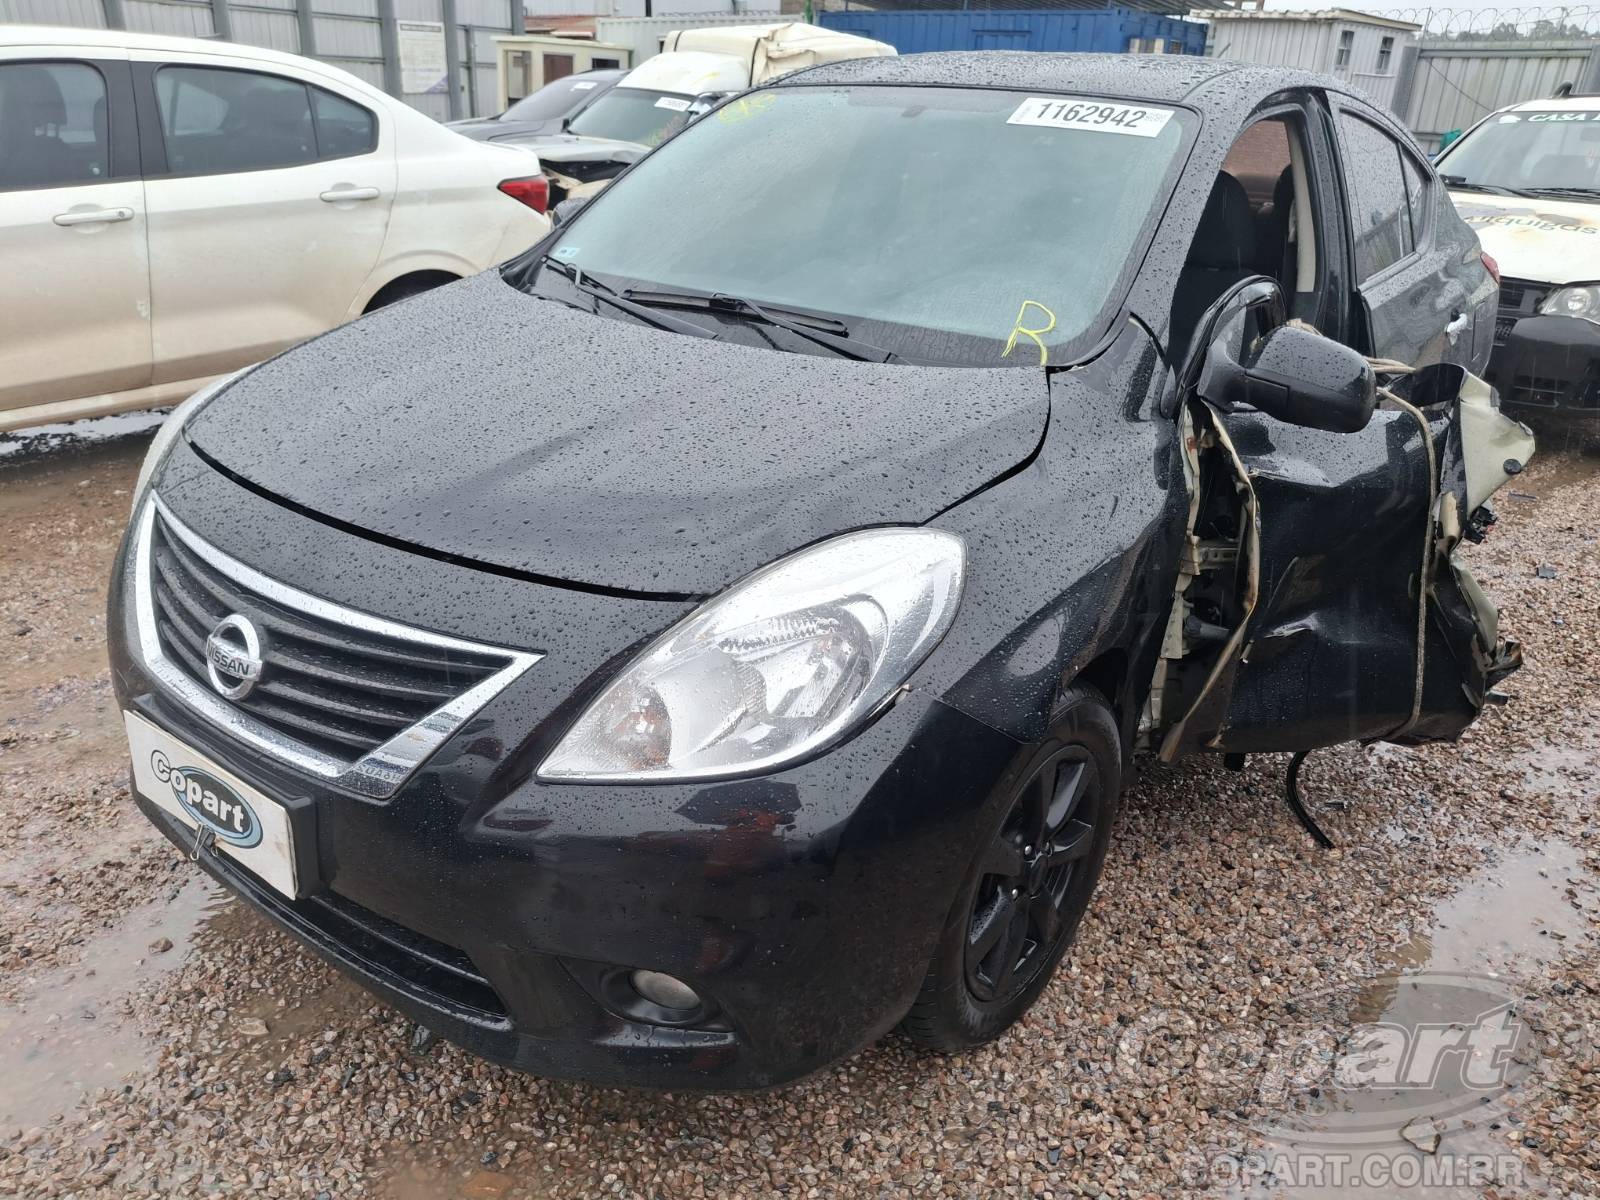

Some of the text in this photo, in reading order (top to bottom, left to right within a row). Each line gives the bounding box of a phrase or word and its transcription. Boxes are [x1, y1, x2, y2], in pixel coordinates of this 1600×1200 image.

[1036, 101, 1148, 129] 1162942
[1528, 113, 1586, 122] CASA
[1000, 299, 1056, 367] R
[207, 640, 250, 676] NISSAN
[151, 749, 245, 834] Copart
